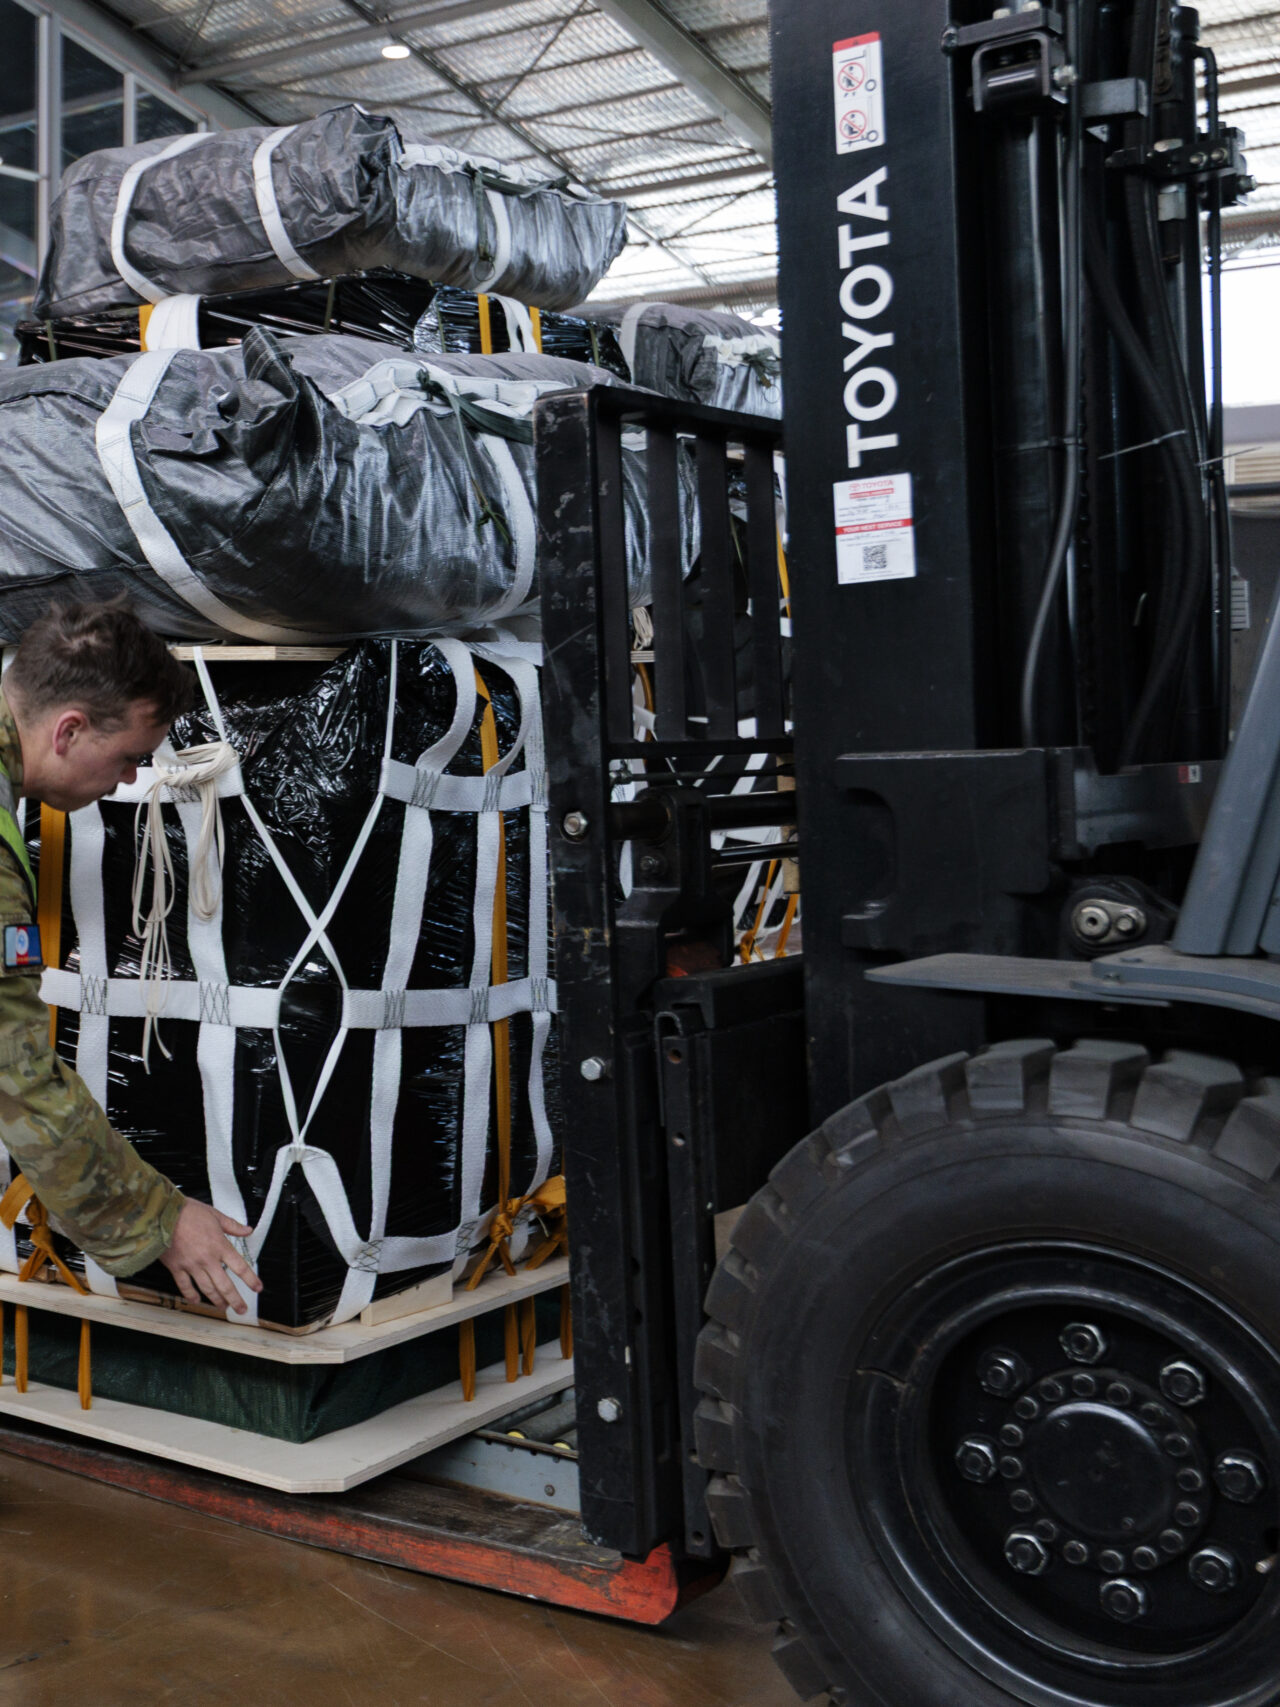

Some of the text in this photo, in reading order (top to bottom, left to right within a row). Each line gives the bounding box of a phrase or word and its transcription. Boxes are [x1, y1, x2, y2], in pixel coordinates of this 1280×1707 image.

[836, 165, 899, 469] TOYOTA
[861, 479, 894, 488] TOYOTA
[843, 526, 860, 534] YOUR
[877, 521, 902, 530] SERVICE
